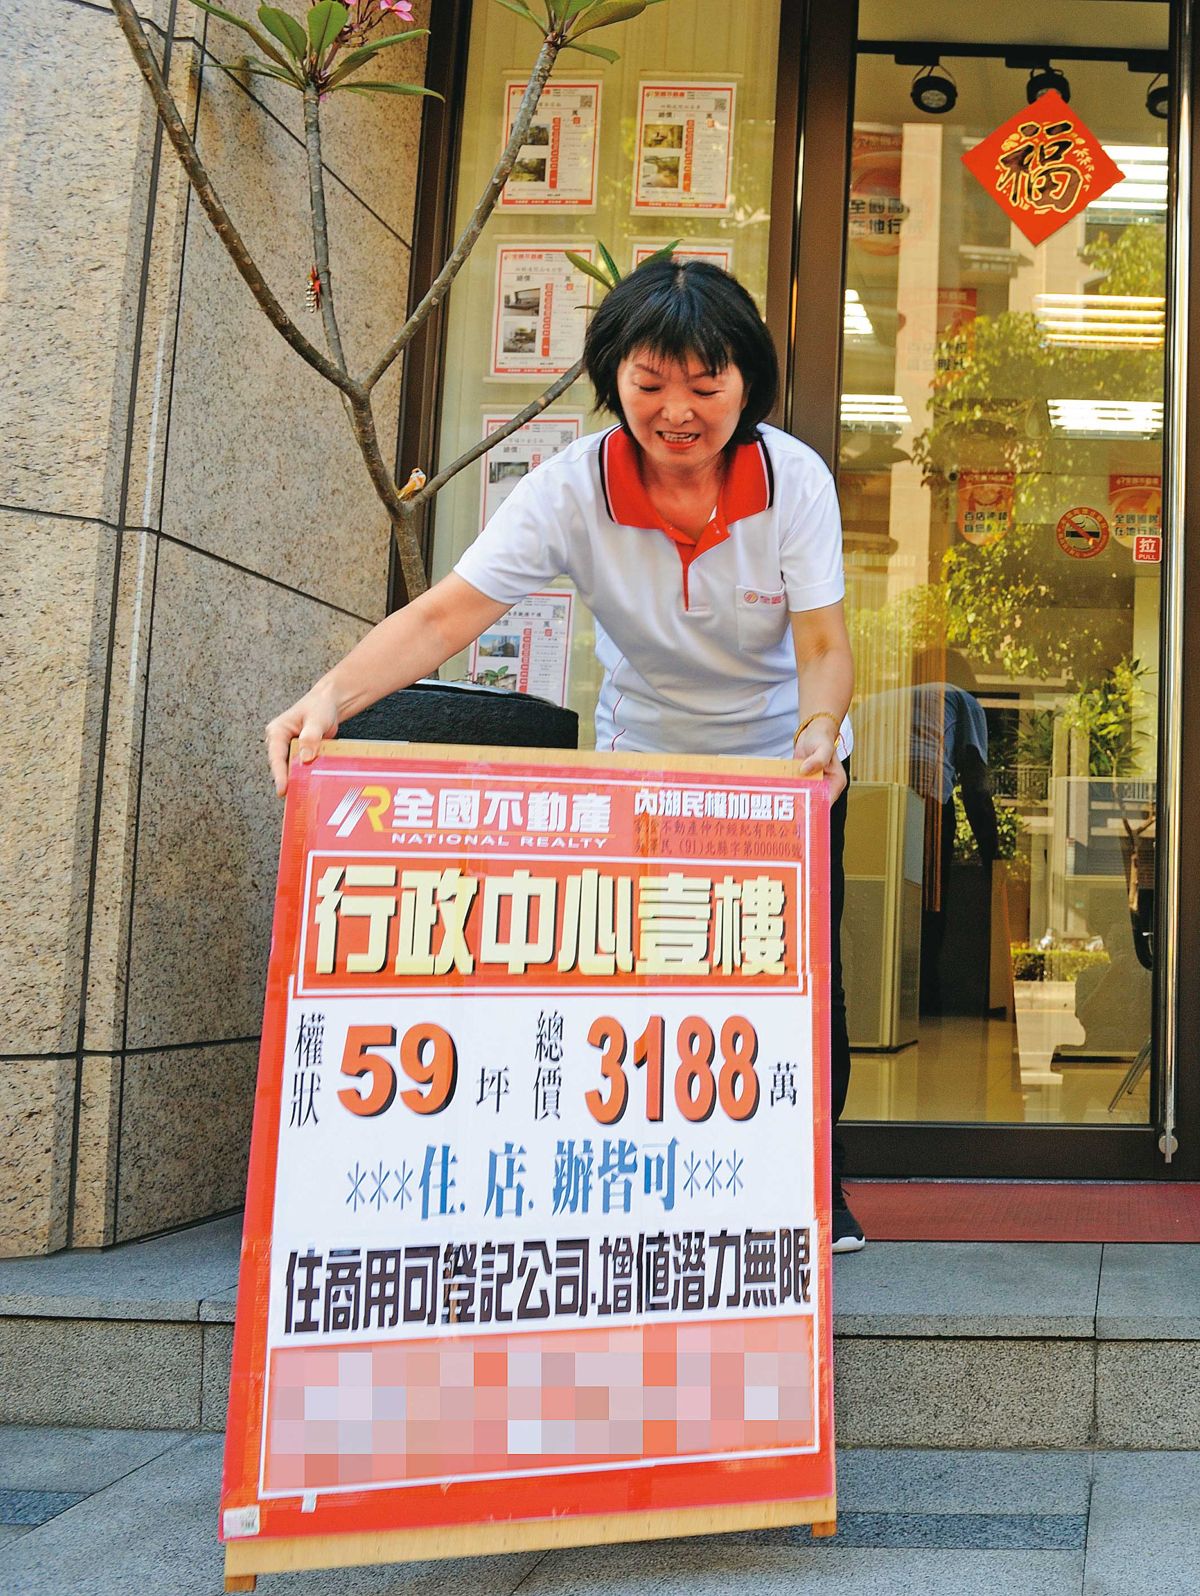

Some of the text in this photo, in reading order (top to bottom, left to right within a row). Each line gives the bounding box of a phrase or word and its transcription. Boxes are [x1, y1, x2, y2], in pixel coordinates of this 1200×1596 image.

[996, 120, 1083, 214] 福
[1138, 537, 1157, 553] 拉
[392, 787, 612, 835] 全國不動產
[634, 788, 795, 821] 內湖民權加盟店
[391, 834, 608, 850] NATIONAL REALTY
[315, 866, 787, 979] 行政中心壹樓
[289, 1010, 798, 1129] 權狀 59 坪 總價 3188 萬
